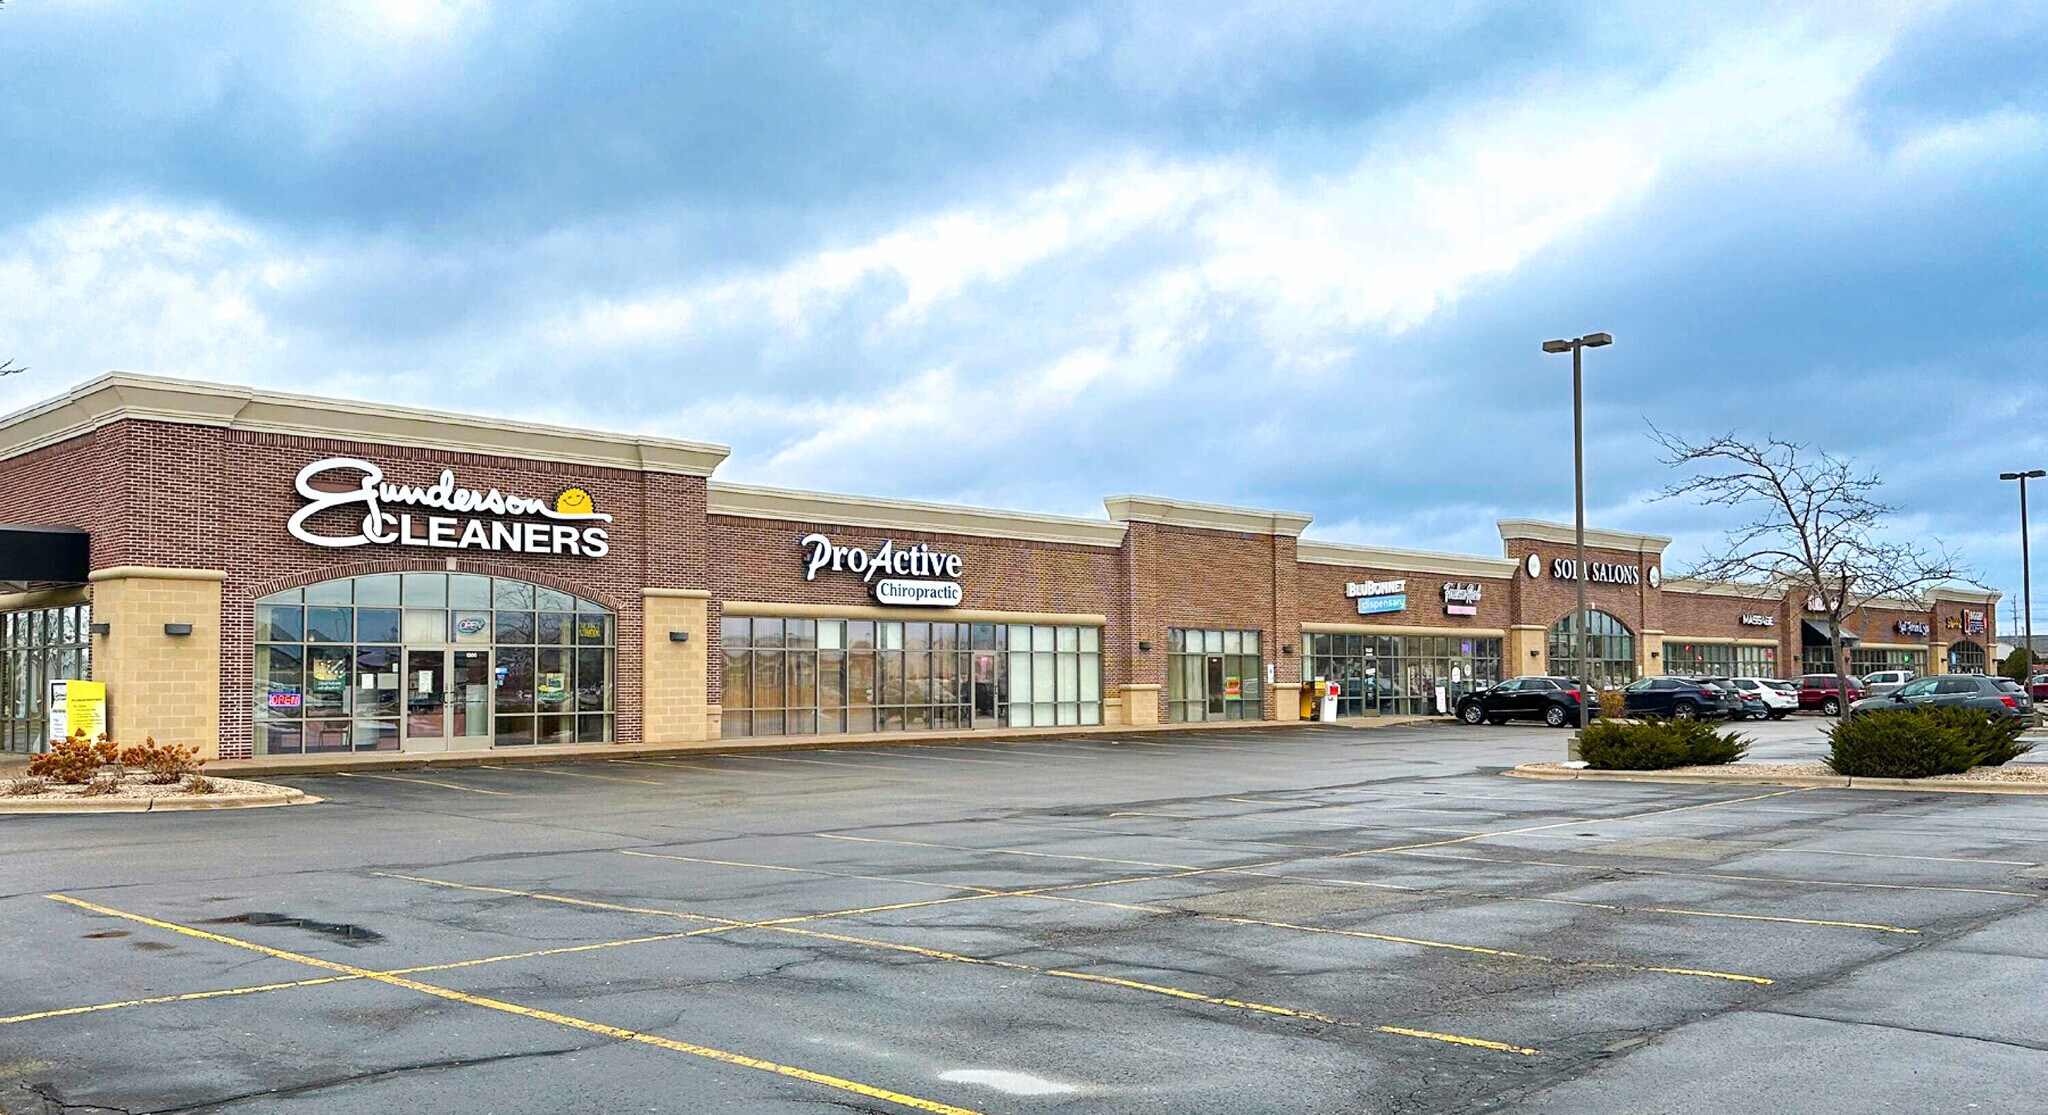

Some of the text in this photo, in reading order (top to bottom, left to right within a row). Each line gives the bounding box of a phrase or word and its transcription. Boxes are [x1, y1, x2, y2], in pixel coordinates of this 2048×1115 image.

[287, 457, 613, 547] Gunderson
[362, 515, 610, 558] CLEANERS
[801, 533, 963, 583] ProActive
[1592, 562, 1640, 584] SALONS
[880, 582, 959, 600] Chiropractic
[1362, 598, 1406, 611] dispensary
[1742, 614, 1774, 626] MASSAGE
[270, 693, 299, 706] OPEN
